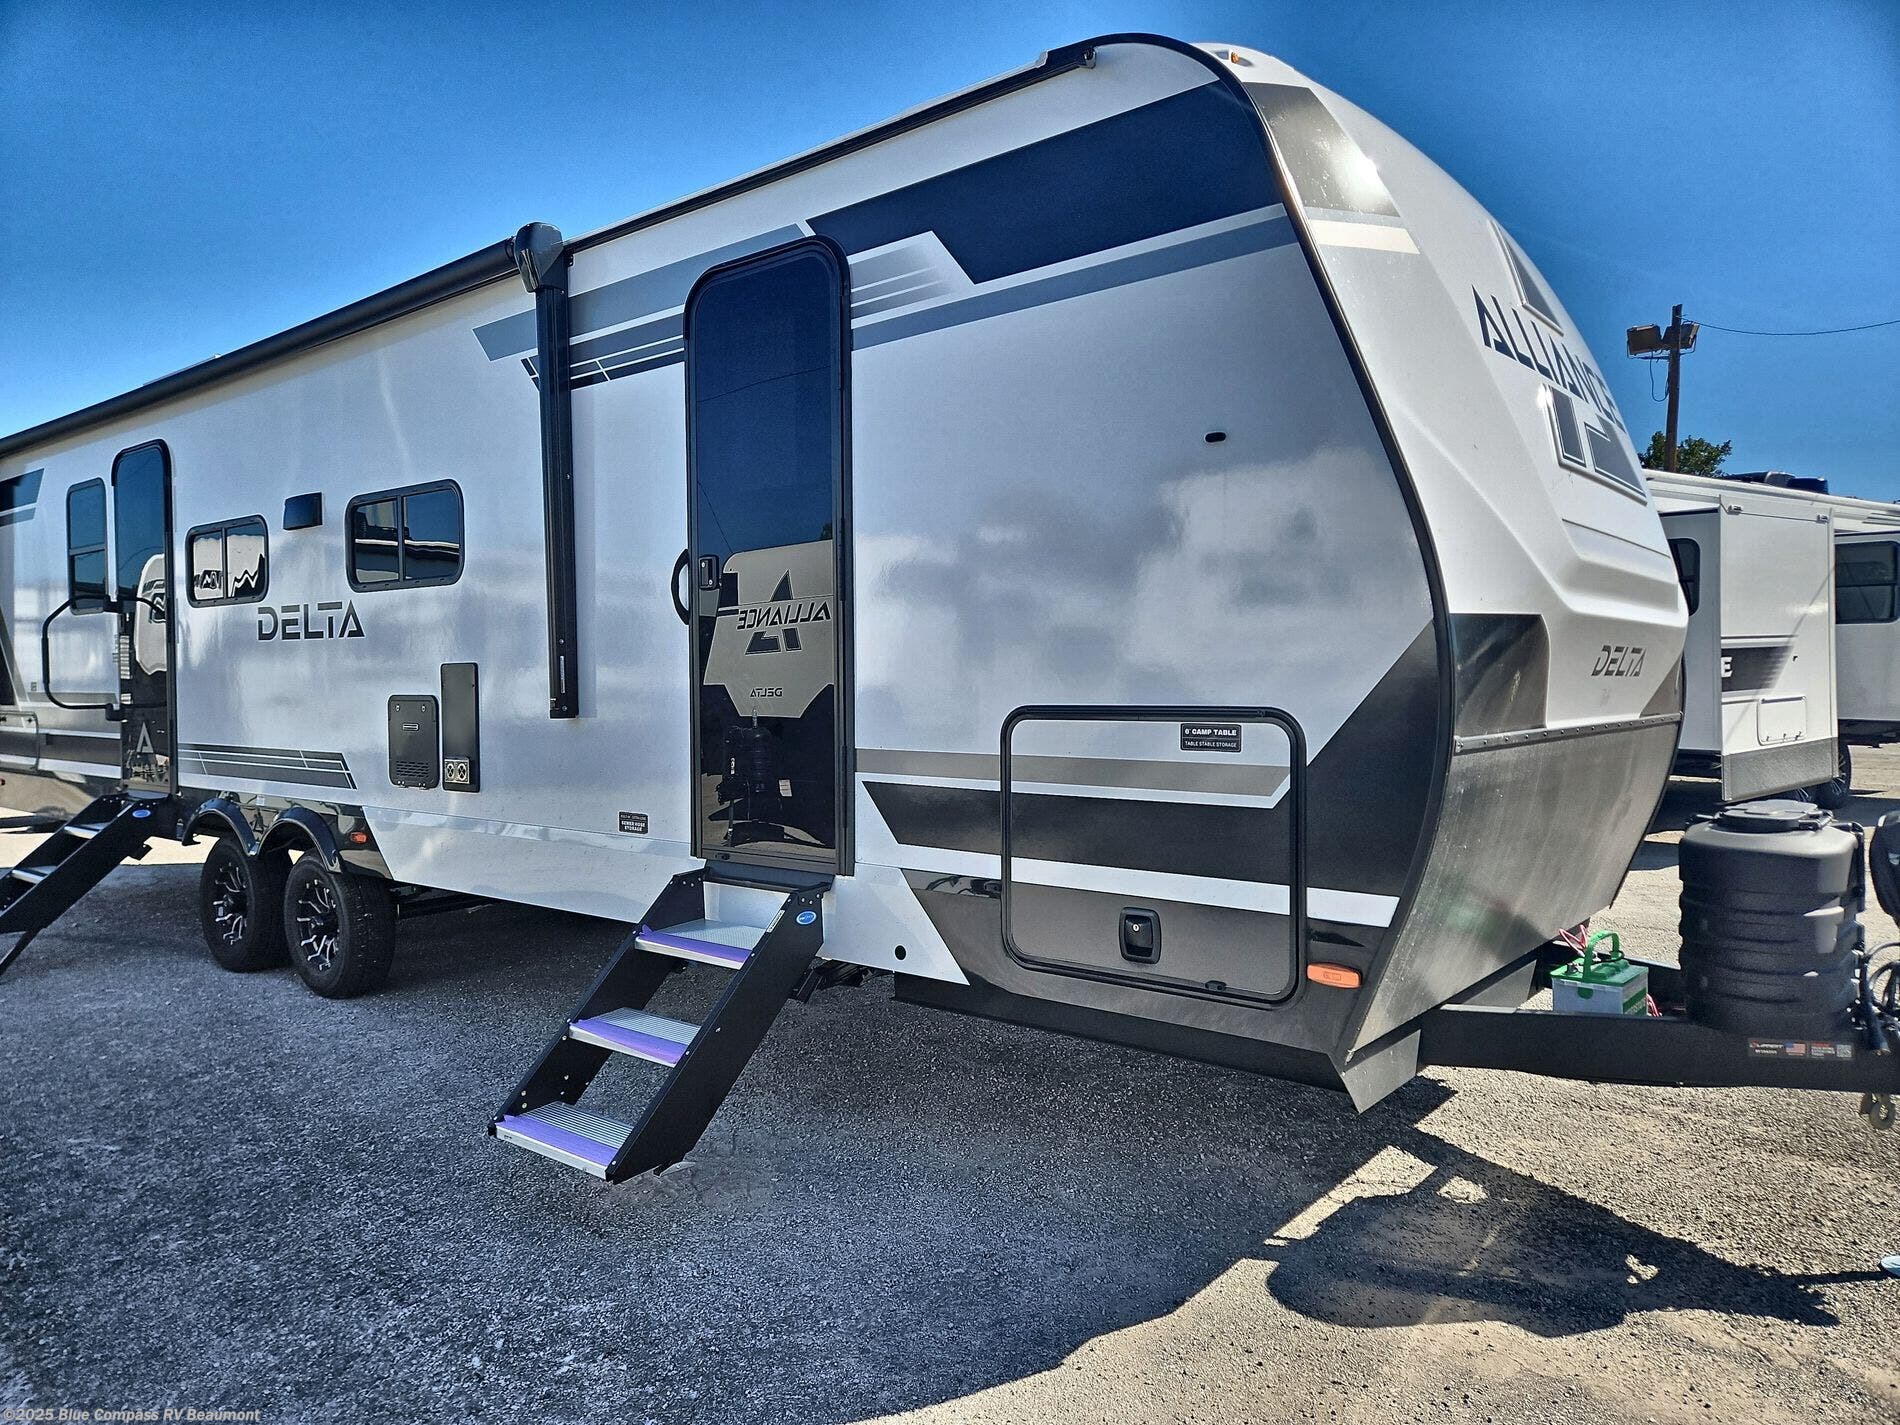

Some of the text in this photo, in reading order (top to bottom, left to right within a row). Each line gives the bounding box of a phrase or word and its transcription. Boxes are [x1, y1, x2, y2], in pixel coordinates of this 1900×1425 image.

[1471, 284, 1627, 434] ALLIANCE
[257, 600, 365, 641] DELTA
[1591, 644, 1646, 677] DELTA
